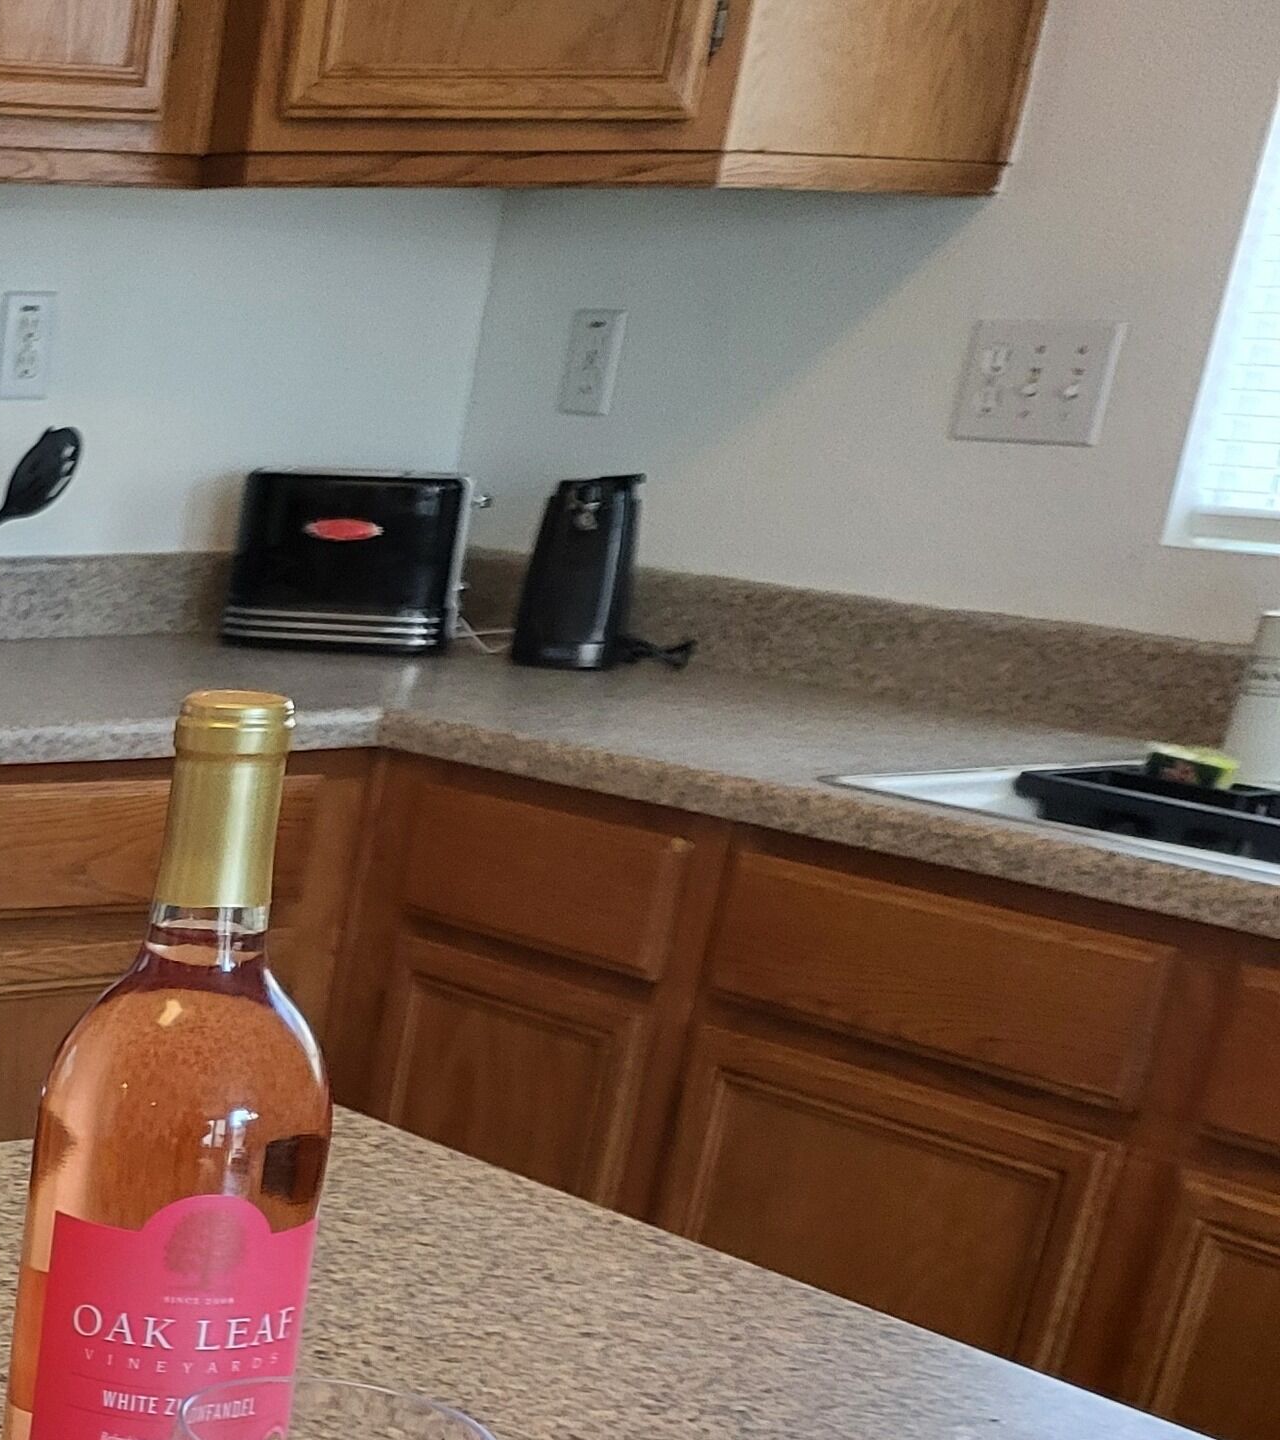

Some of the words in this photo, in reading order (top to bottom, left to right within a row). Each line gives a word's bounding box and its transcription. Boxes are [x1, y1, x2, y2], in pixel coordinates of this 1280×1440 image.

[73, 1304, 176, 1351] OAK
[195, 1305, 296, 1351] LEAF
[84, 1348, 279, 1375] VINEYARDS
[102, 1389, 158, 1416] WHITE
